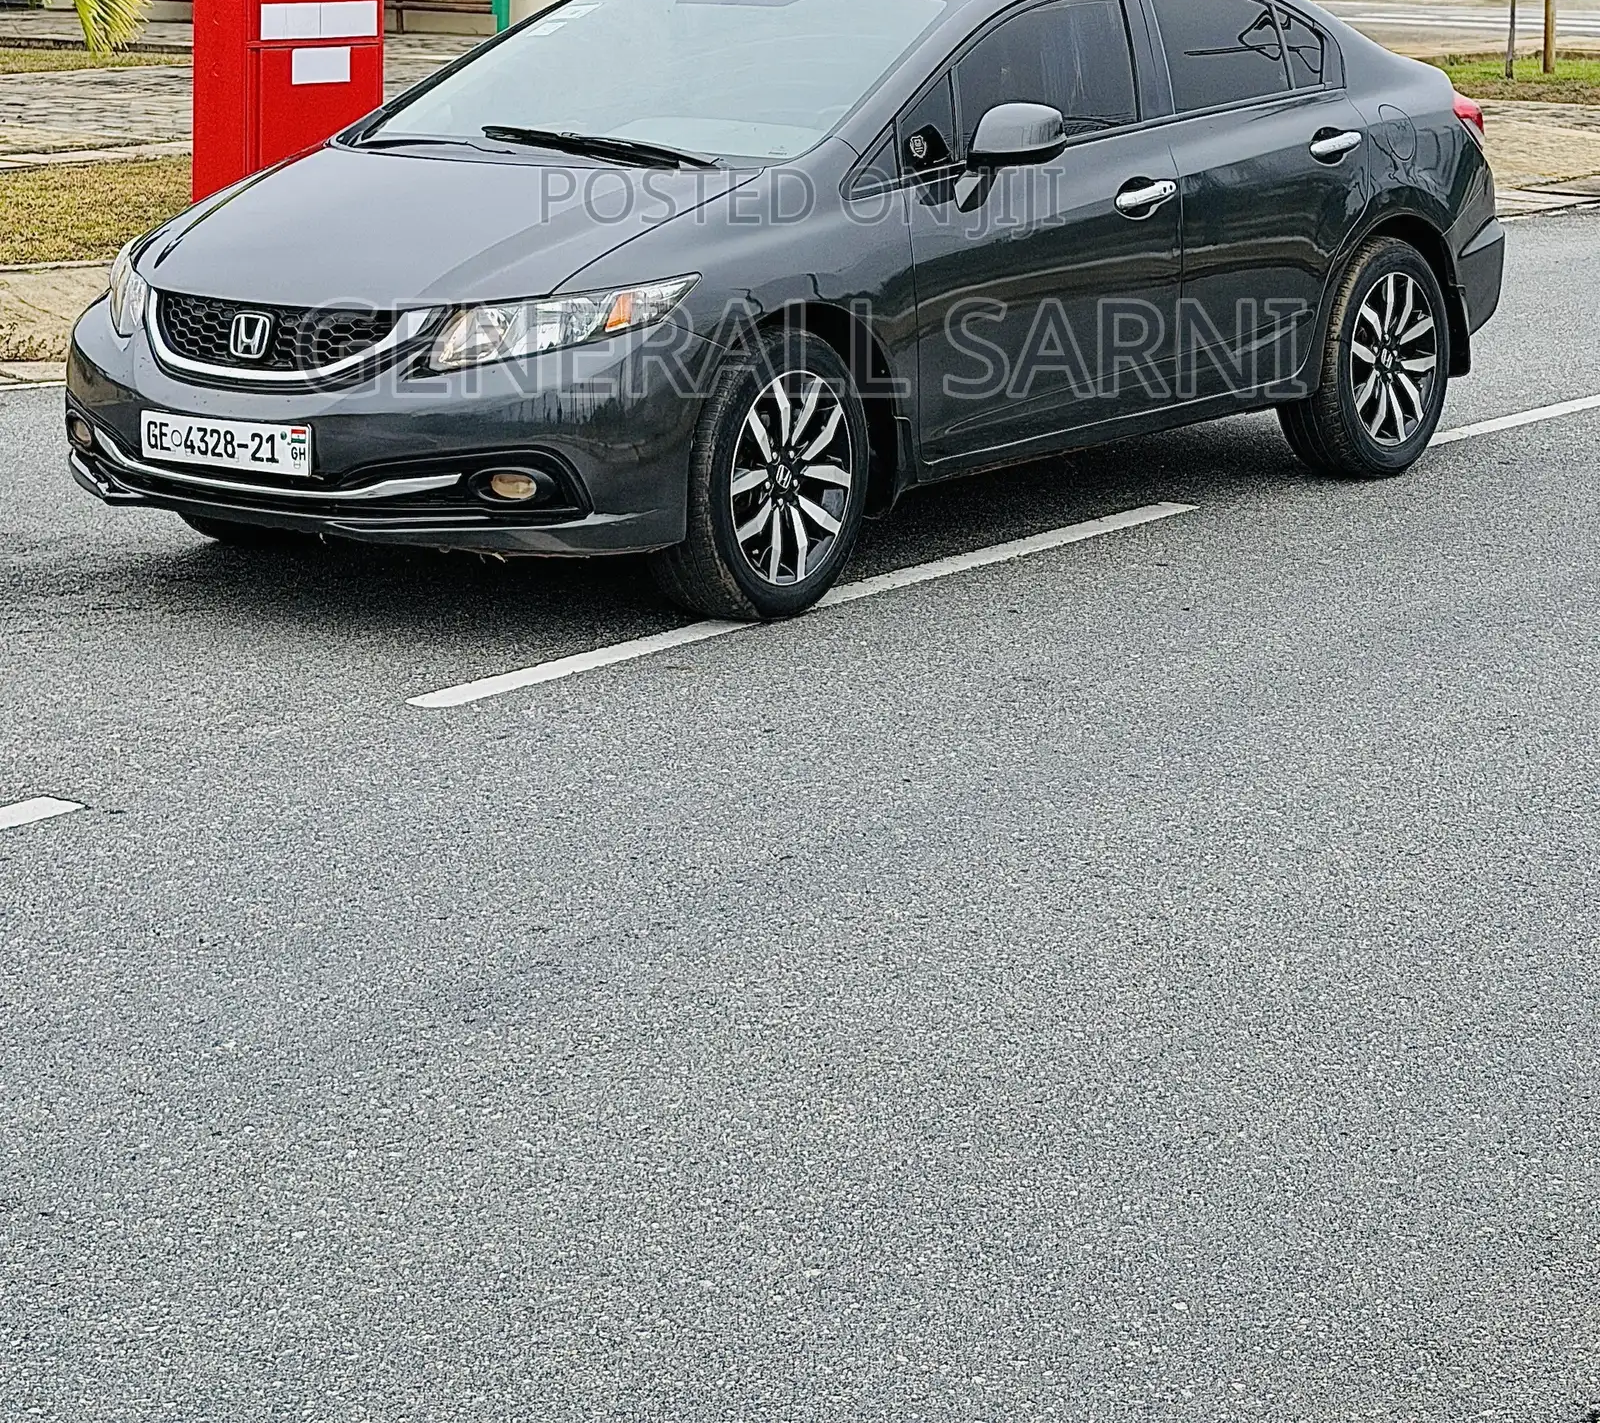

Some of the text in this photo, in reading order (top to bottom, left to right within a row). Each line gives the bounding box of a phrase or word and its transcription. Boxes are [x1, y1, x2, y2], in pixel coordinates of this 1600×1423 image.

[146, 420, 280, 464] GE 4328-21
[291, 446, 306, 461] GH
